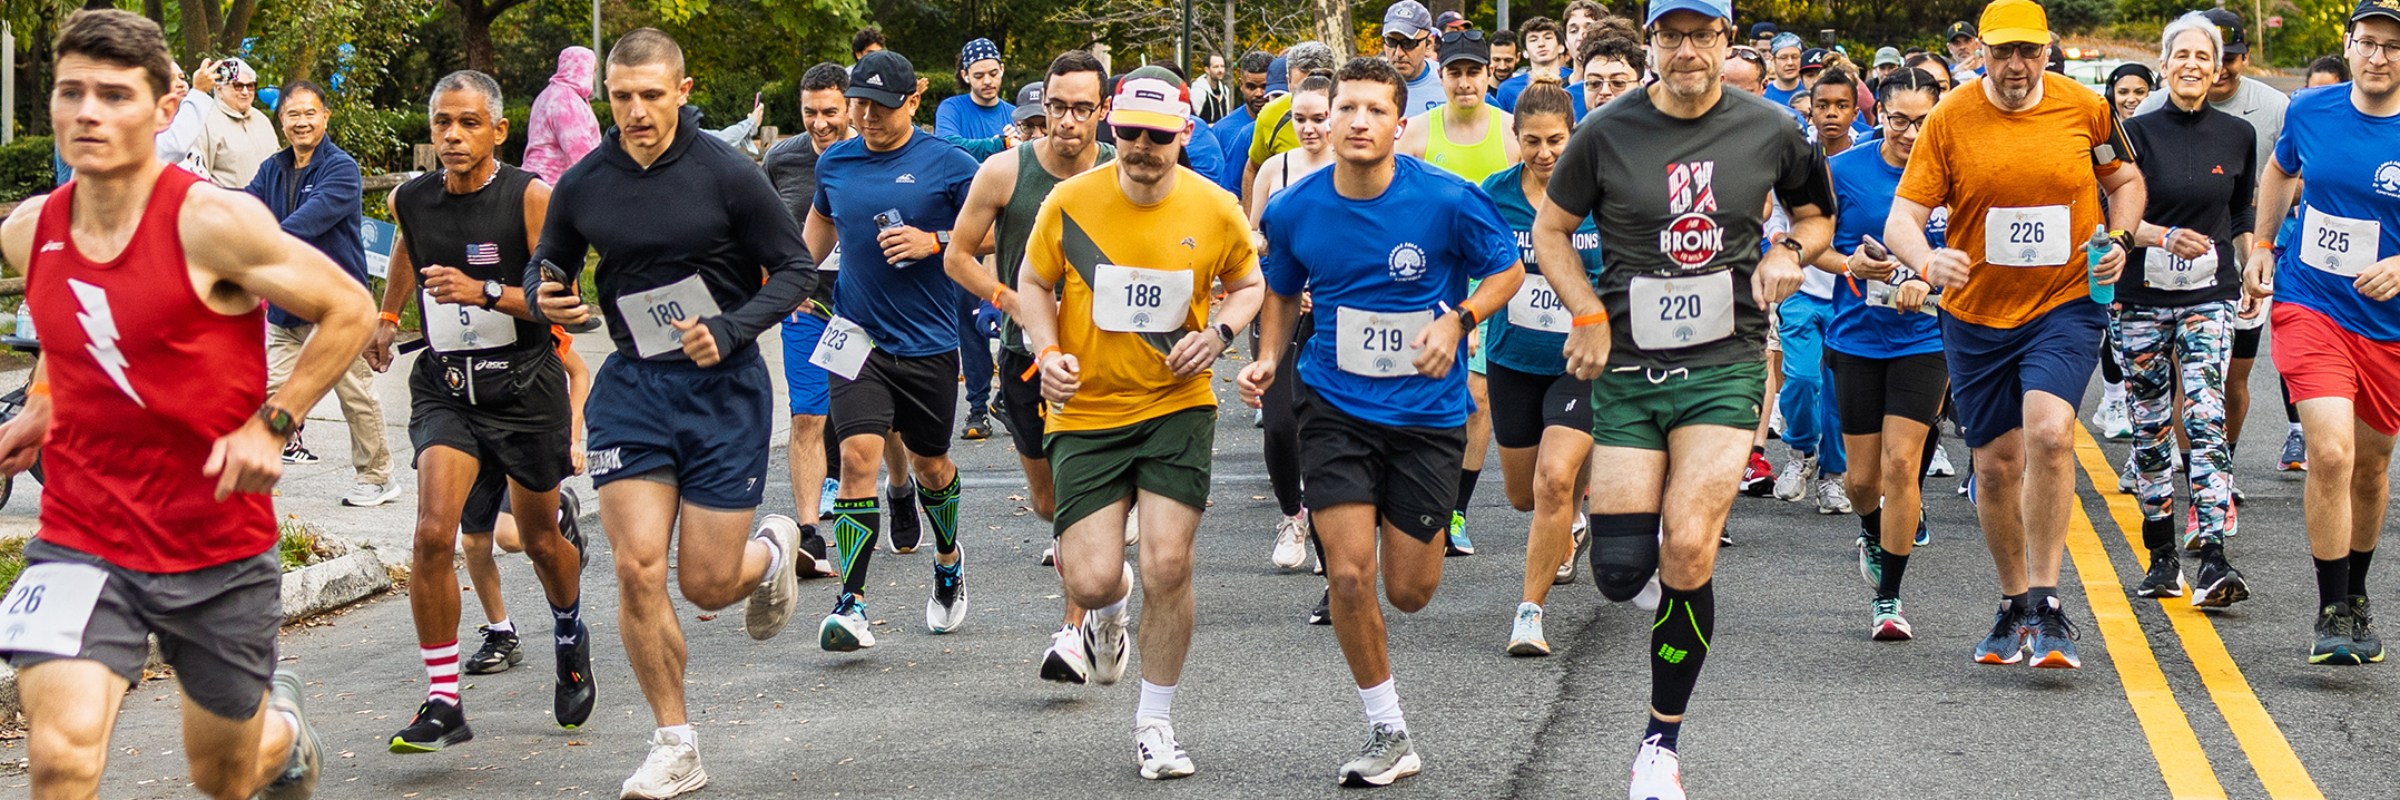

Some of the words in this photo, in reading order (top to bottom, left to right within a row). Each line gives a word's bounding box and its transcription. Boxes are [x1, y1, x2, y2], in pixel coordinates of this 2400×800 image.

[1666, 161, 1718, 214] BX
[1660, 227, 1724, 253] BRONX
[2010, 222, 2045, 243] 226
[2318, 227, 2350, 253] 225
[1124, 283, 1162, 308] 188
[1530, 288, 1563, 311] 204
[1659, 294, 1702, 321] 220
[459, 303, 470, 326] 5
[647, 301, 686, 328] 180
[822, 326, 849, 352] 223
[1363, 327, 1403, 352] 219
[9, 584, 47, 614] 26
